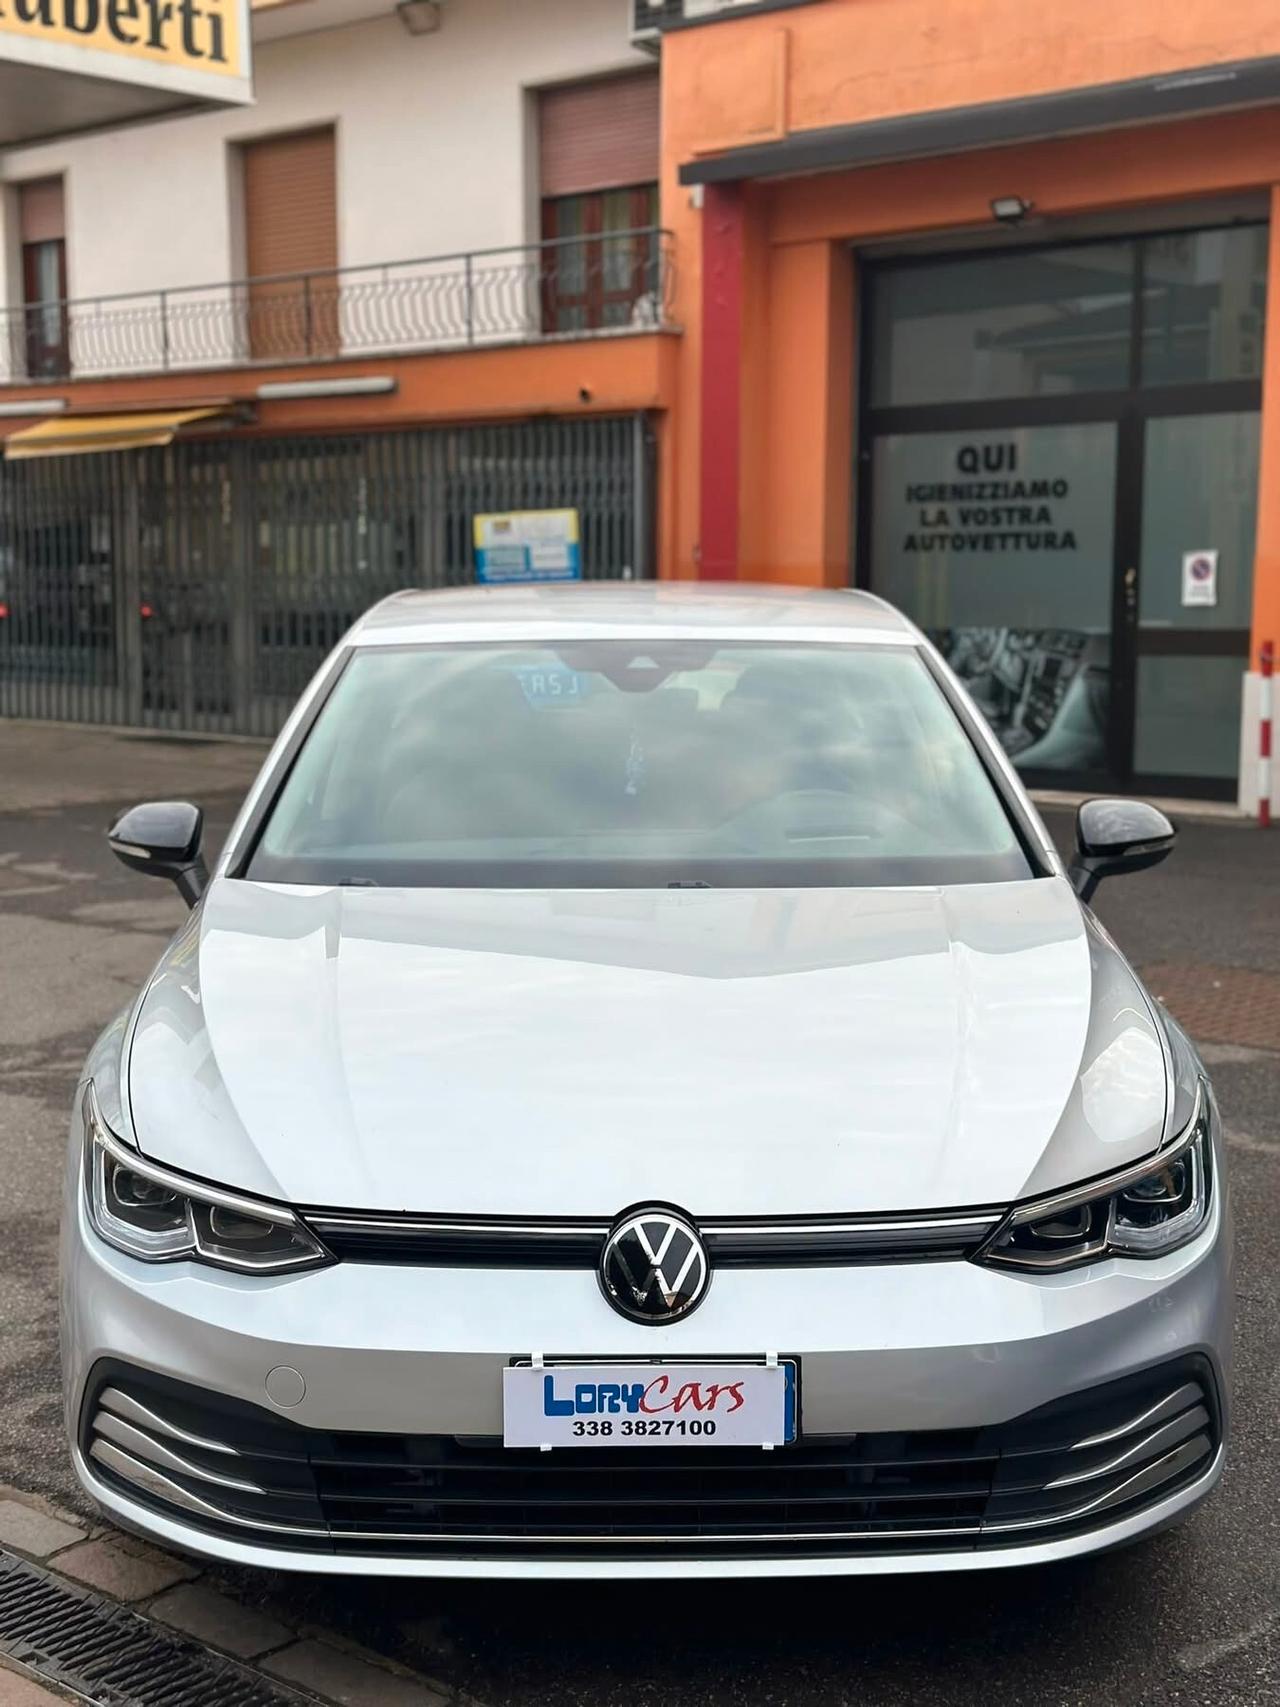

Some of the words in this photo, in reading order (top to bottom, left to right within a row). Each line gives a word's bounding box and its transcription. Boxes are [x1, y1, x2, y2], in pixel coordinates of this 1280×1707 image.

[956, 443, 1016, 474] QUI
[905, 479, 1068, 503] IGIENIZZIAMO
[919, 508, 950, 527] LA
[959, 505, 1052, 526] VOSTRA
[903, 530, 1077, 551] AUTOVETTURA
[572, 1420, 613, 1436] 338
[620, 1420, 717, 1436] 3827100
